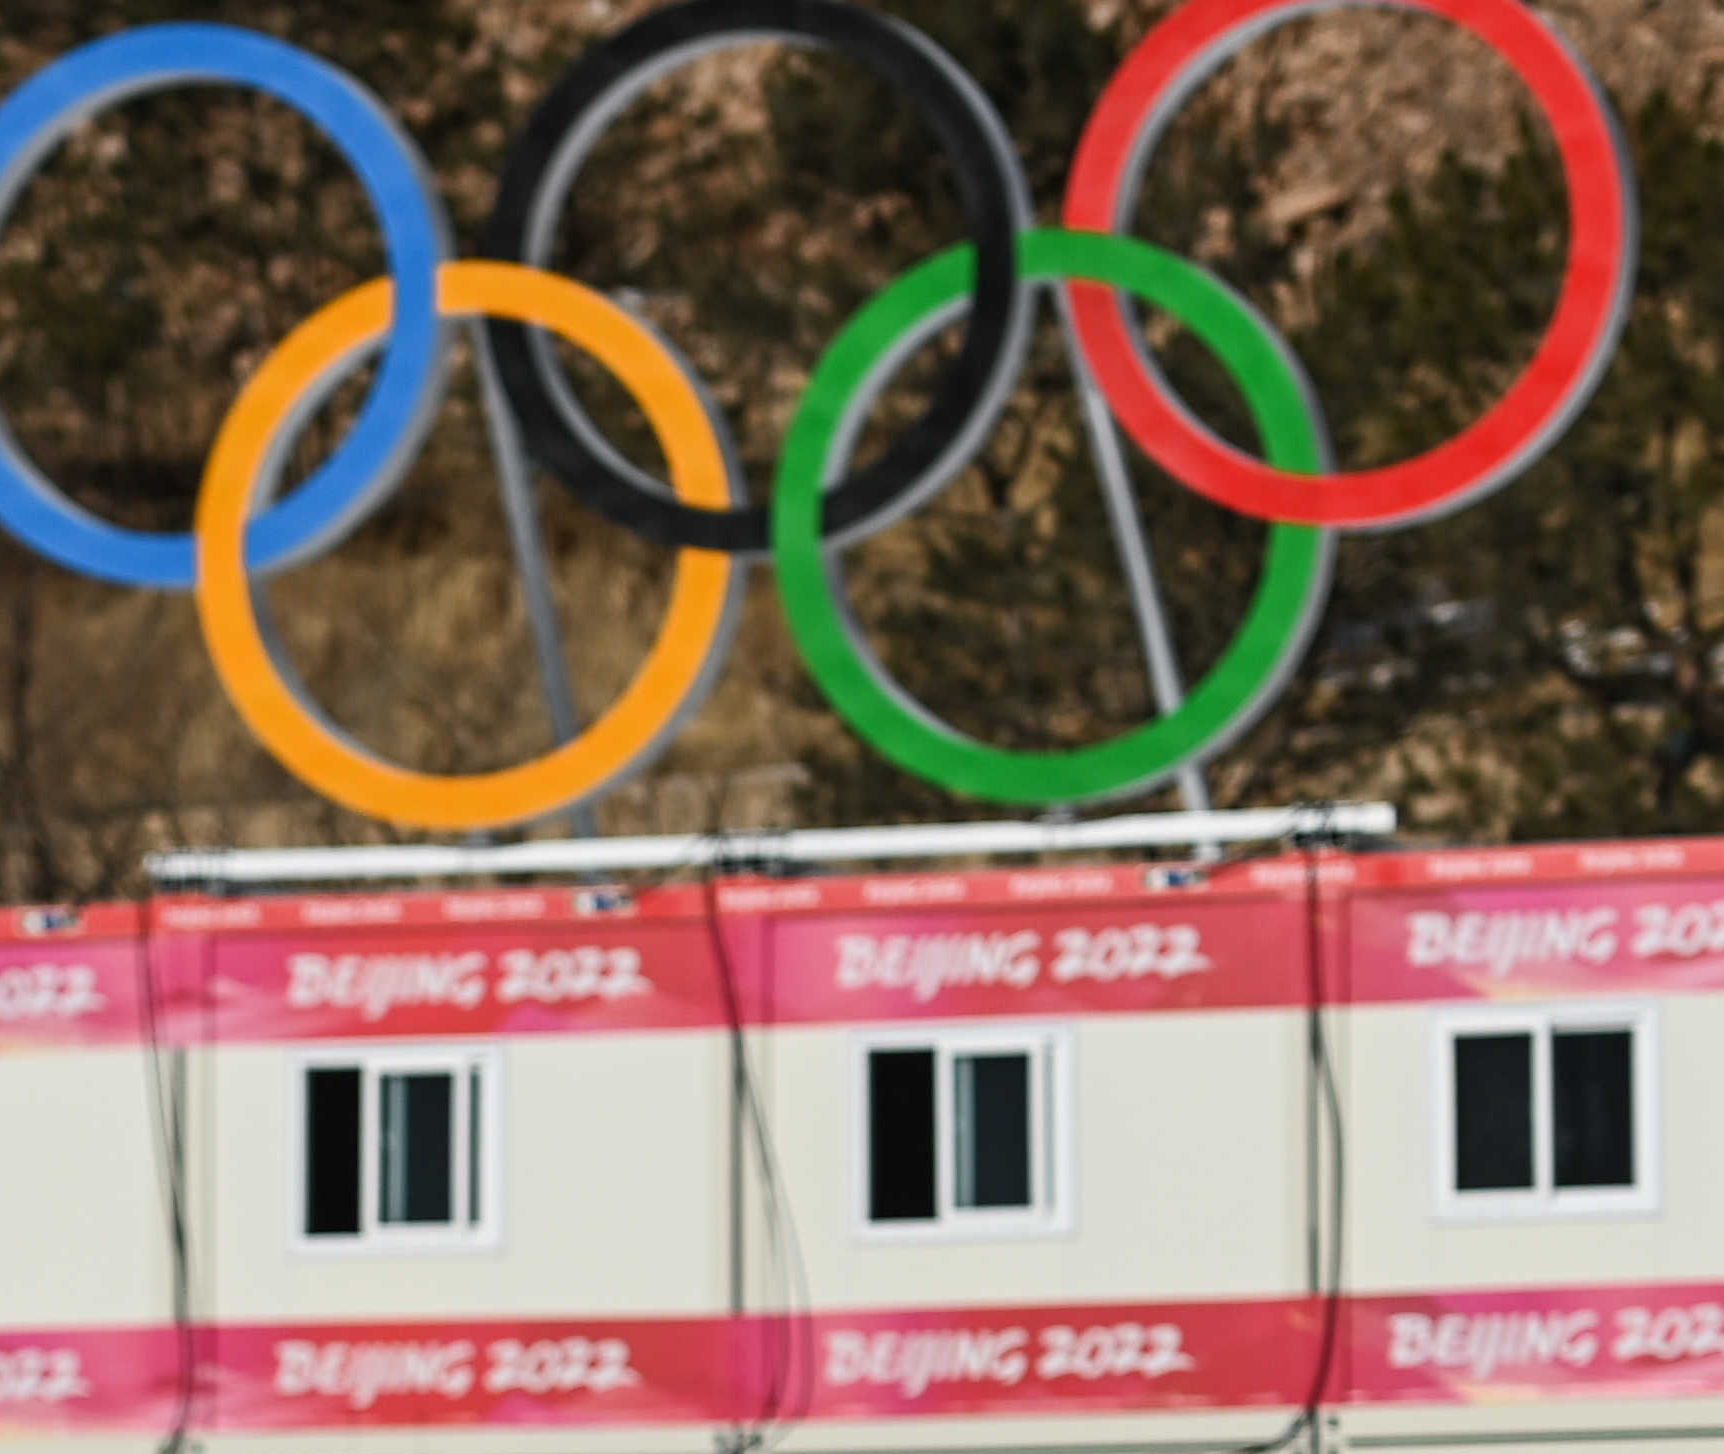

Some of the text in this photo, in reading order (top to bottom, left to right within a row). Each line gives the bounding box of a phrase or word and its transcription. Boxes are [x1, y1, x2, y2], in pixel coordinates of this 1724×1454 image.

[833, 925, 1209, 1000] BEIJING 2022
[1408, 907, 1618, 977] BEIJING
[286, 947, 650, 1019] BEIJING 2022
[273, 1338, 637, 1407] BEIJING 2022
[822, 1323, 1191, 1396] BEIJING 2022
[1390, 1310, 1598, 1374] BEIJING
